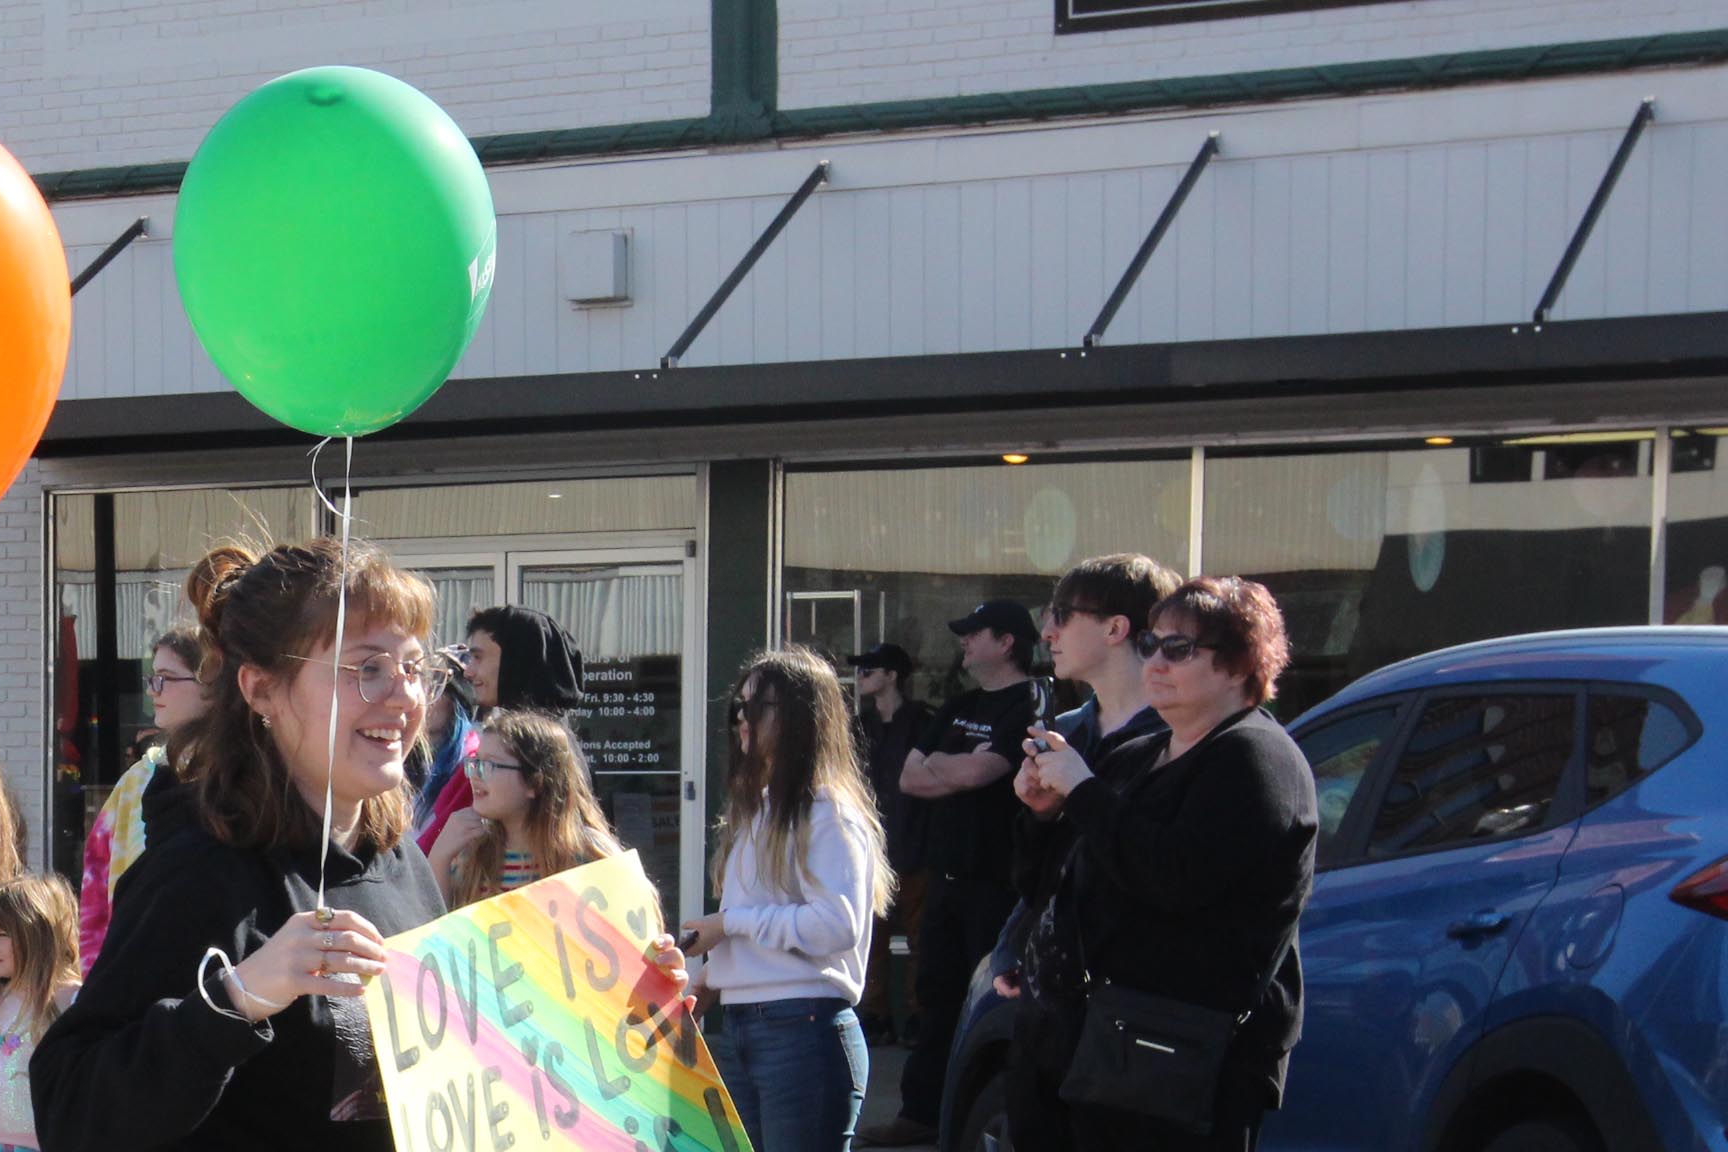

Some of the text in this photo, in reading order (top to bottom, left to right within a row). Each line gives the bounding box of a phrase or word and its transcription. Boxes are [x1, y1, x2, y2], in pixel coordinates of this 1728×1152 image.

[603, 692, 624, 702] 9:30
[633, 692, 655, 702] 4:30
[599, 706, 624, 716] 10:00
[633, 706, 655, 716] 4:00
[603, 739, 651, 751] Accepted
[603, 753, 629, 763] 10:00
[638, 752, 659, 762] 2:00
[381, 921, 534, 1073] LOVE
